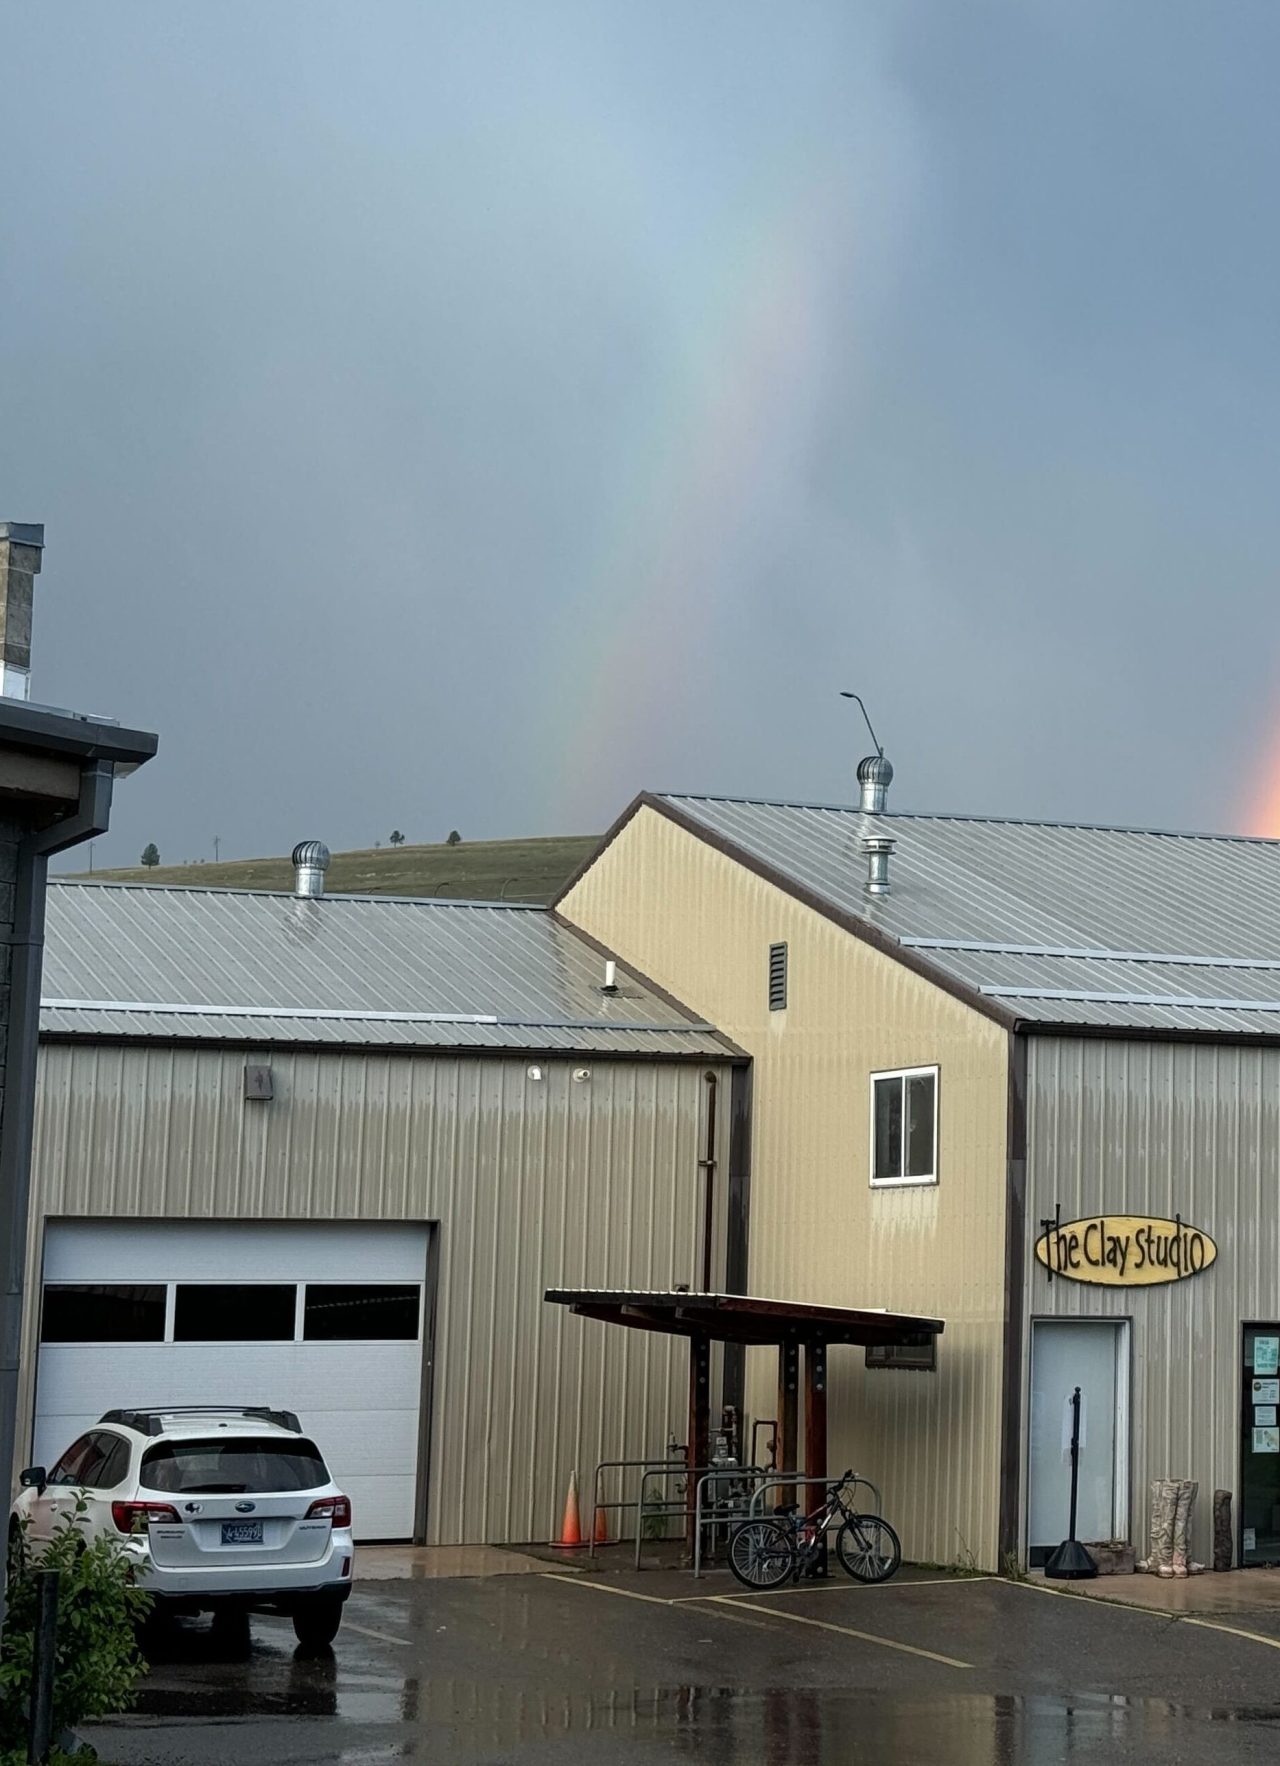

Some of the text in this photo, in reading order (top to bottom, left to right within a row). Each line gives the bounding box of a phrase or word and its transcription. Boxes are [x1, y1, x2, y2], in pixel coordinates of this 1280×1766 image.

[1040, 1203, 1205, 1282] The Clay Studio
